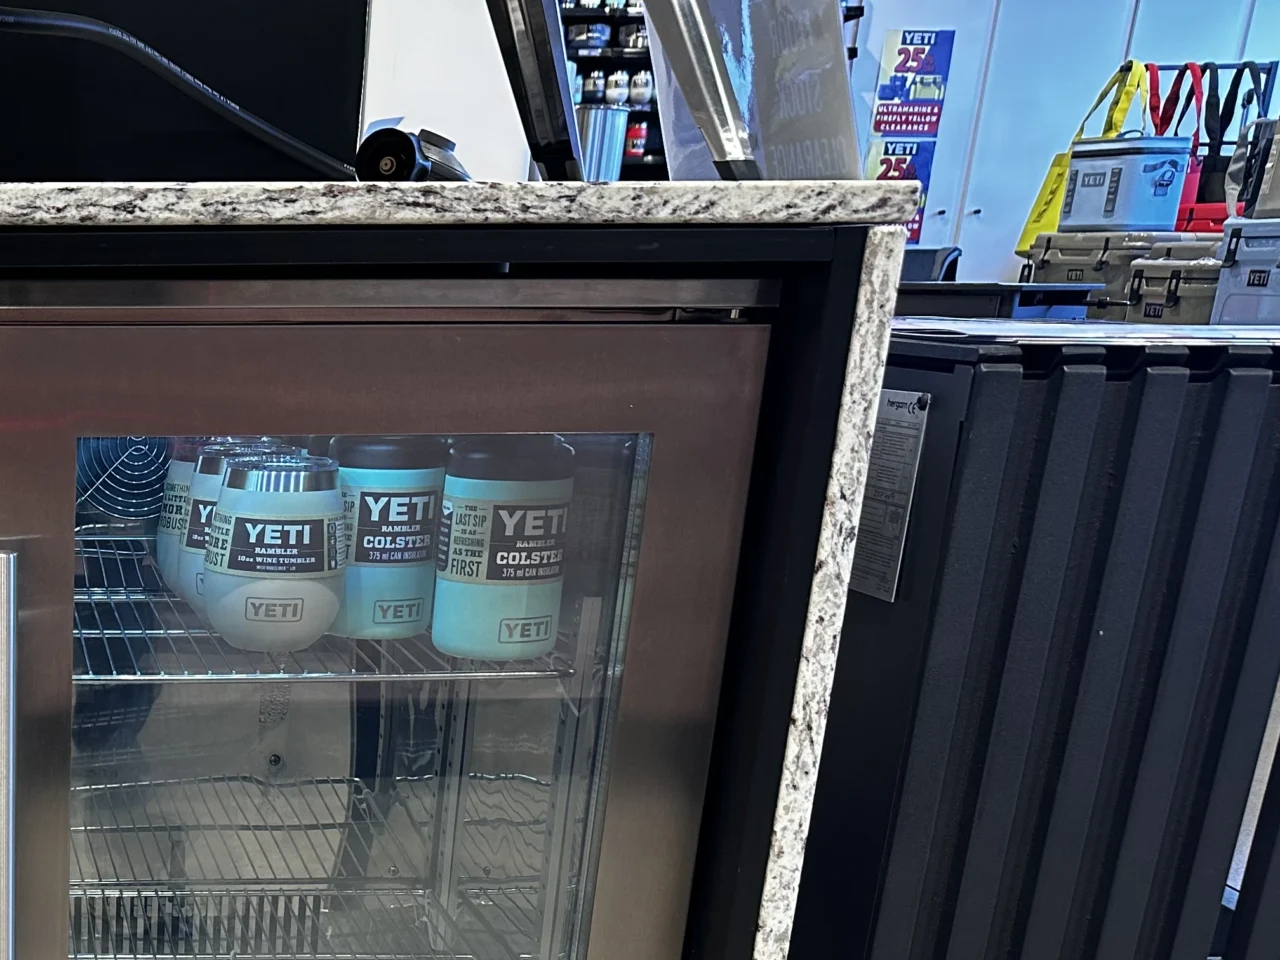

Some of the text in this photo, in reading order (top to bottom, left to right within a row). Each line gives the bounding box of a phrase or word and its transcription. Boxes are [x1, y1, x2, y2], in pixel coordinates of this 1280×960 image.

[905, 32, 936, 44] YETI
[887, 143, 917, 155] YETI
[1083, 175, 1104, 185] YETI
[1068, 271, 1083, 280] YETI
[1249, 273, 1269, 284] YETI
[1146, 306, 1162, 316] YETI
[364, 495, 435, 521] YETI
[455, 513, 487, 528] LAST SIP
[498, 508, 568, 536] YETI
[245, 523, 310, 545] YETI
[363, 535, 431, 548] COLSTER
[453, 536, 484, 548] REFRESHING
[516, 539, 555, 548] RAMBLER
[255, 547, 298, 555] RAMBLER
[369, 552, 380, 560] 375
[390, 552, 401, 560] CAN
[452, 548, 483, 558] AS THE
[451, 558, 482, 577] FIRST
[502, 568, 514, 577] 375
[525, 568, 536, 577] CAN
[250, 602, 299, 618] YETI
[378, 603, 420, 619] YETI
[504, 621, 549, 638] YETI
